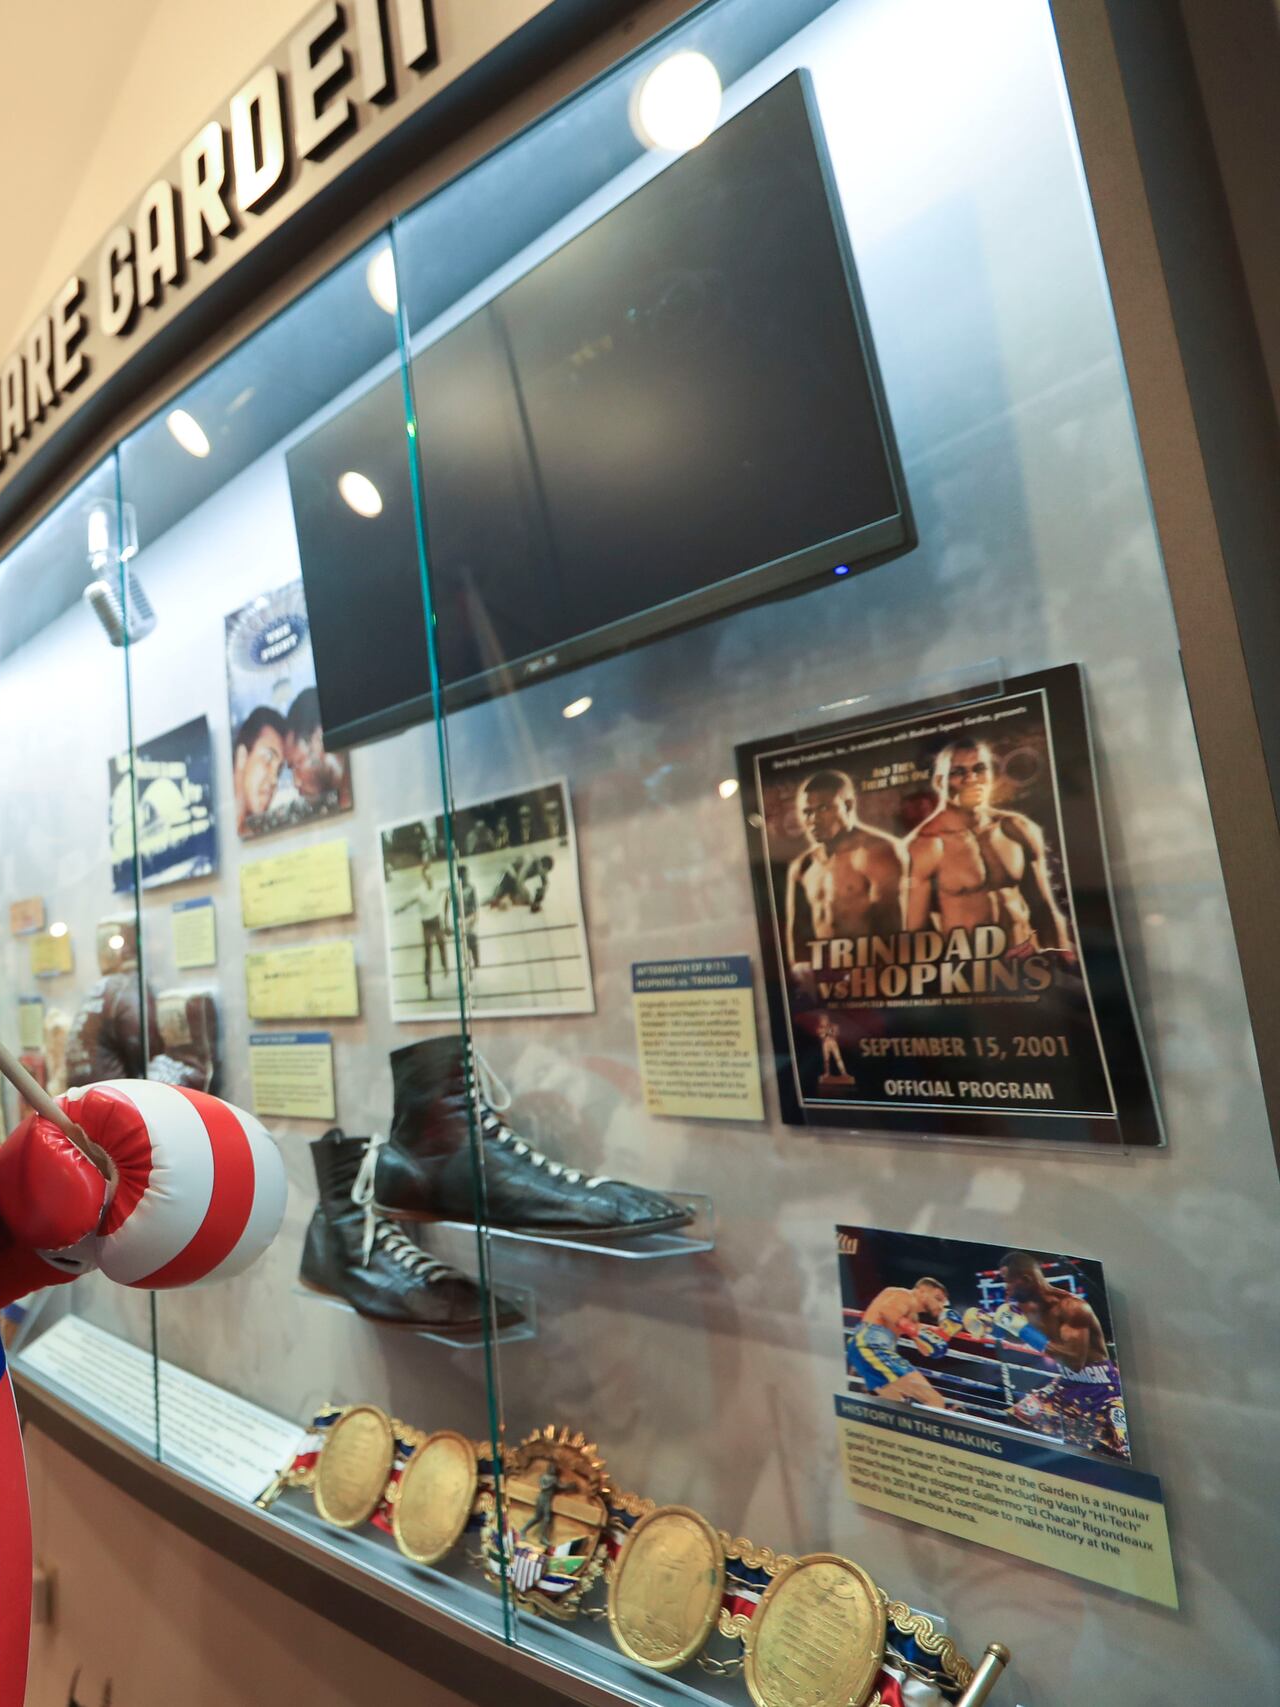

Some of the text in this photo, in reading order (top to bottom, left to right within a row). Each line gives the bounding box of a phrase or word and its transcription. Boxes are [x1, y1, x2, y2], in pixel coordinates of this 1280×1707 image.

[807, 924, 1008, 971] TRINIDAD
[851, 955, 1053, 998] HOPKINS
[859, 1035, 1070, 1060] SEPTEMBER 15, 2001
[884, 1079, 1055, 1100] OFFICIAL PROGRAM
[841, 1402, 1003, 1453] HISTORY IN THE MAKING
[907, 1495, 944, 1512] Famous
[936, 1467, 973, 1482] Current
[975, 1479, 1001, 1492] stars,
[1003, 1486, 1053, 1509] including
[1055, 1500, 1087, 1518] Vasily
[940, 1455, 956, 1466] the
[958, 1462, 1003, 1479] marquee
[1004, 1473, 1015, 1482] of
[1018, 1478, 1035, 1488] the
[1038, 1483, 1078, 1501] Garden
[1081, 1495, 1089, 1504] is
[1102, 1500, 1150, 1522] singular
[929, 1478, 969, 1496] stopped
[971, 1490, 1021, 1511] Guillermo
[1082, 1523, 1153, 1551] Rigondeaux
[954, 1498, 999, 1517] continue
[1000, 1511, 1012, 1521] to
[1015, 1516, 1043, 1531] make
[1046, 1524, 1083, 1544] history
[1086, 1538, 1098, 1548] at
[1100, 1541, 1120, 1555] the
